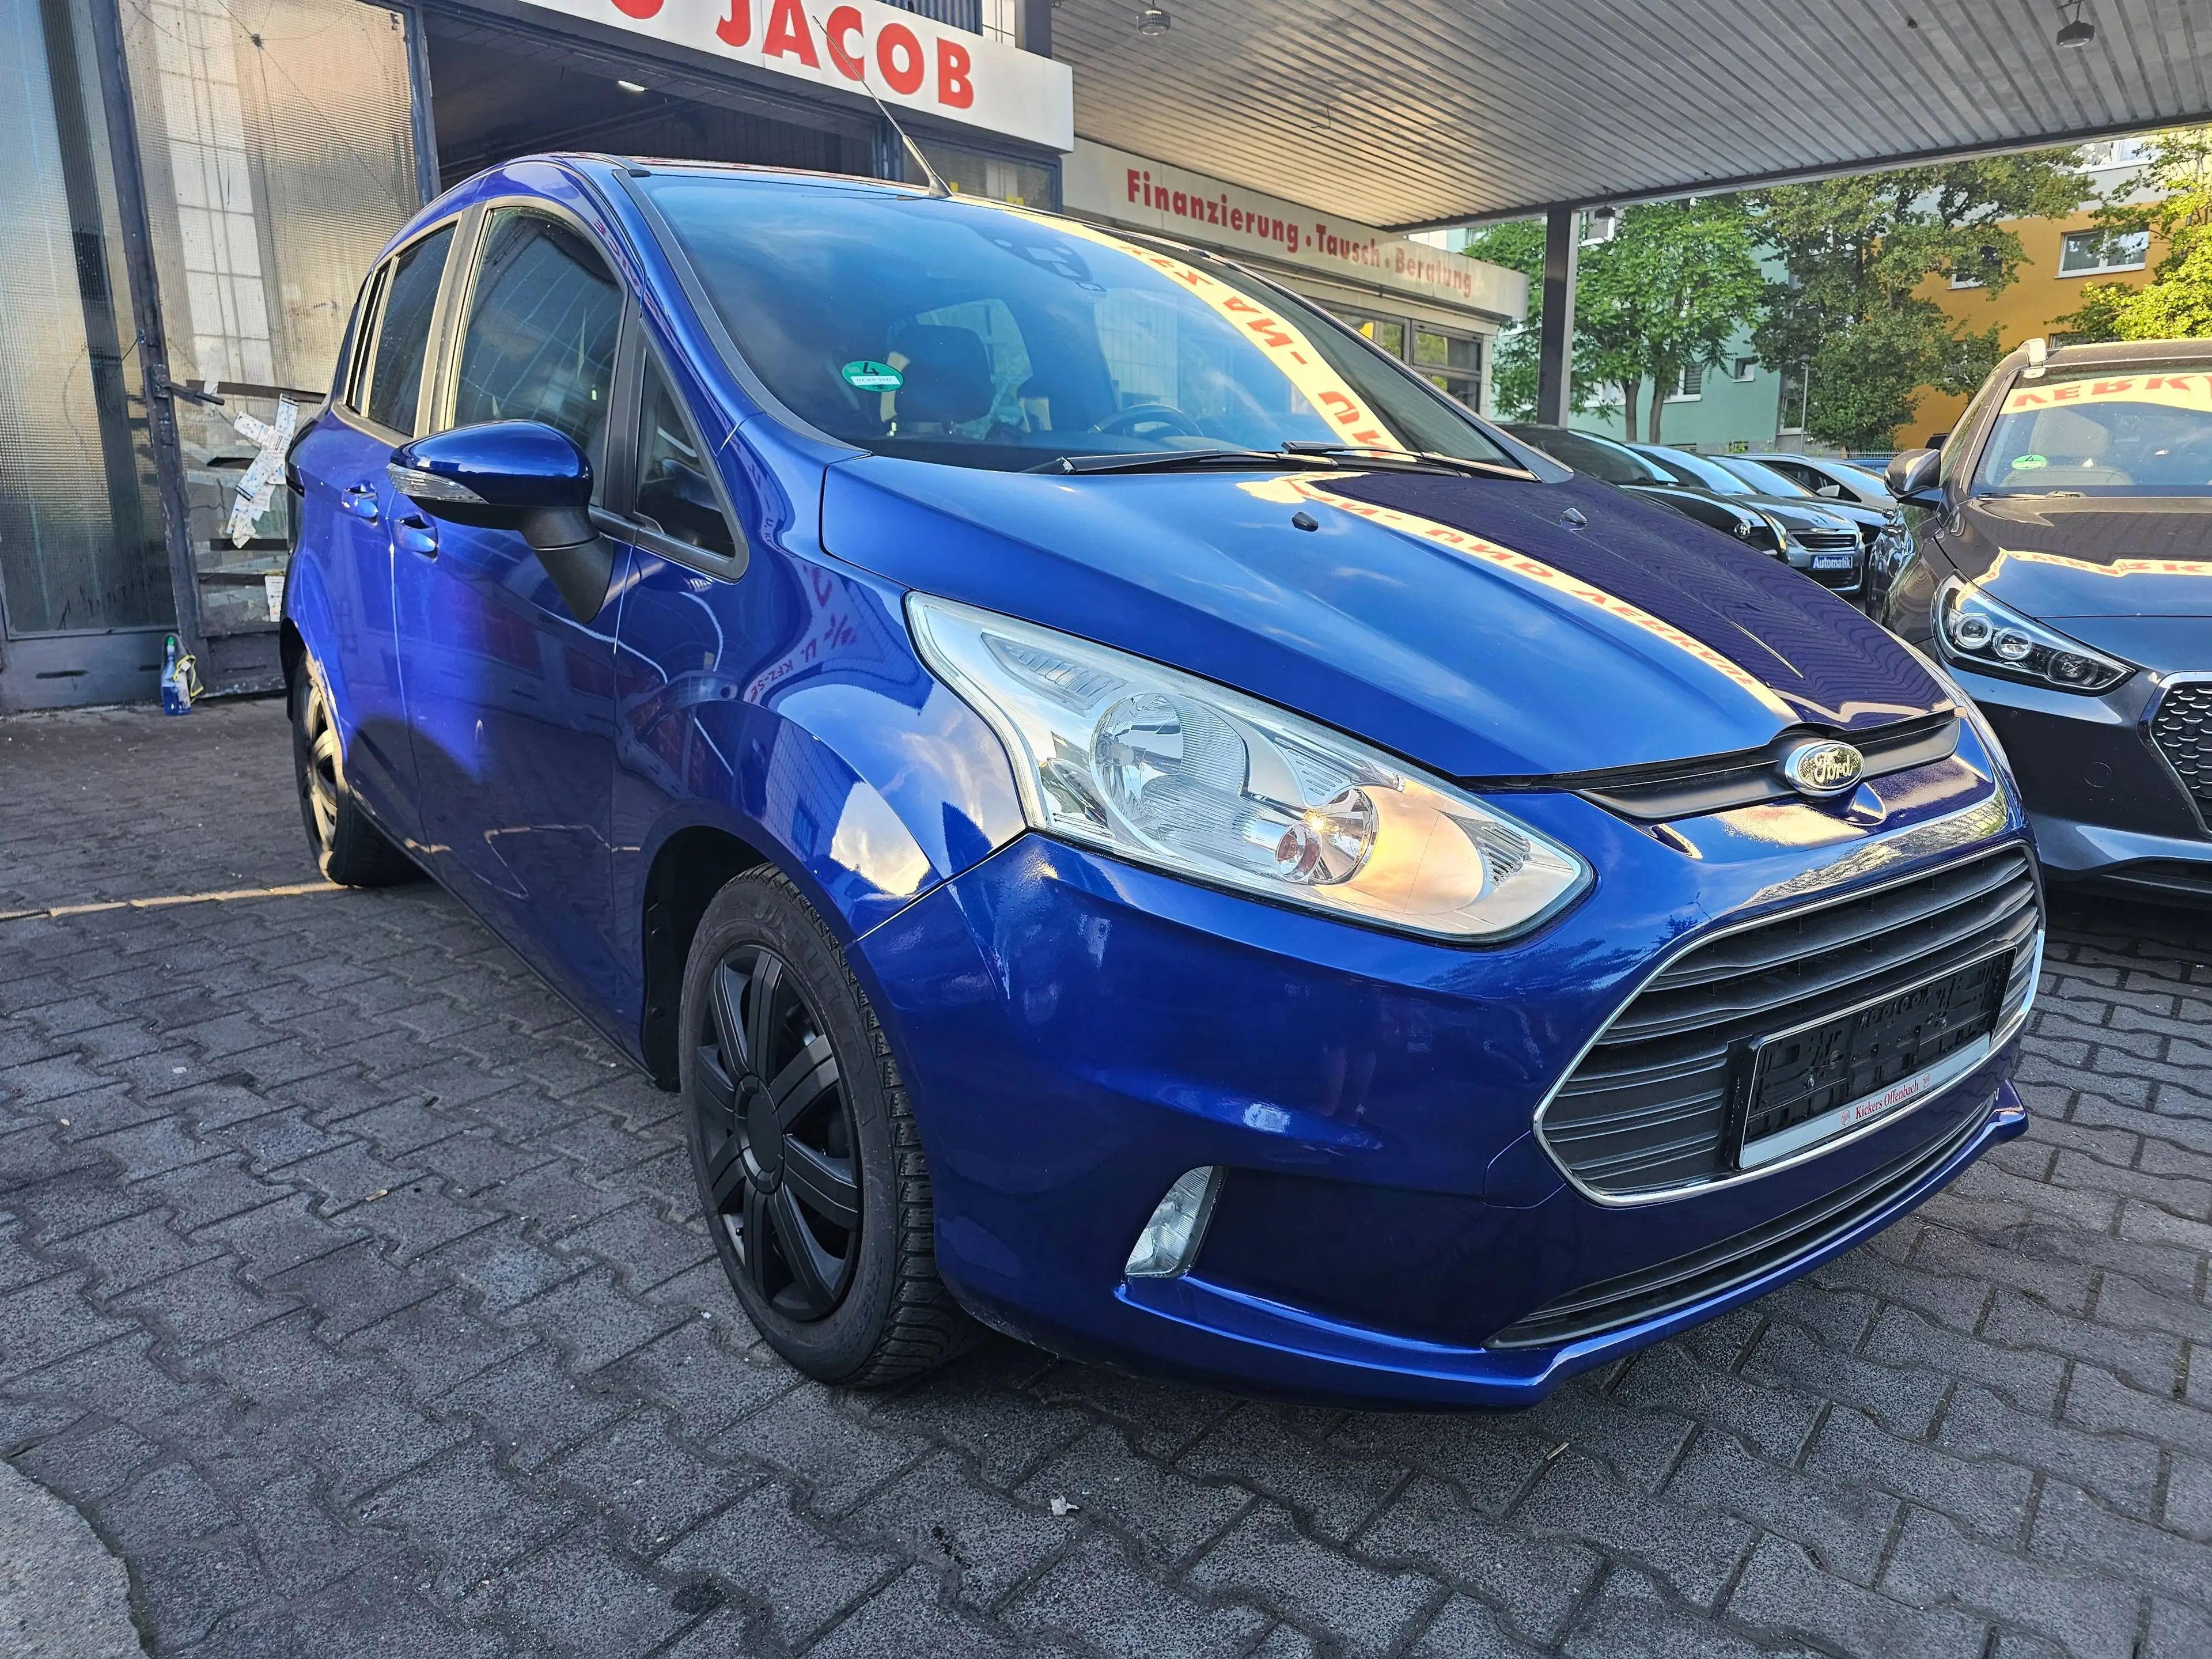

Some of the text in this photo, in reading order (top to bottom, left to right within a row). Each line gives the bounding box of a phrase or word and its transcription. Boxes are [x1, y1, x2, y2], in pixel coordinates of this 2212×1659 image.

[716, 0, 974, 109] JACOB
[1127, 169, 1471, 298] Finanzierung Tausch Beratung
[862, 362, 880, 376] 4
[1813, 556, 1851, 569] Automatik
[1814, 749, 1853, 783] Ford
[1855, 1100, 1883, 1119] Kickers
[1884, 1080, 1918, 1106] Offenbach
